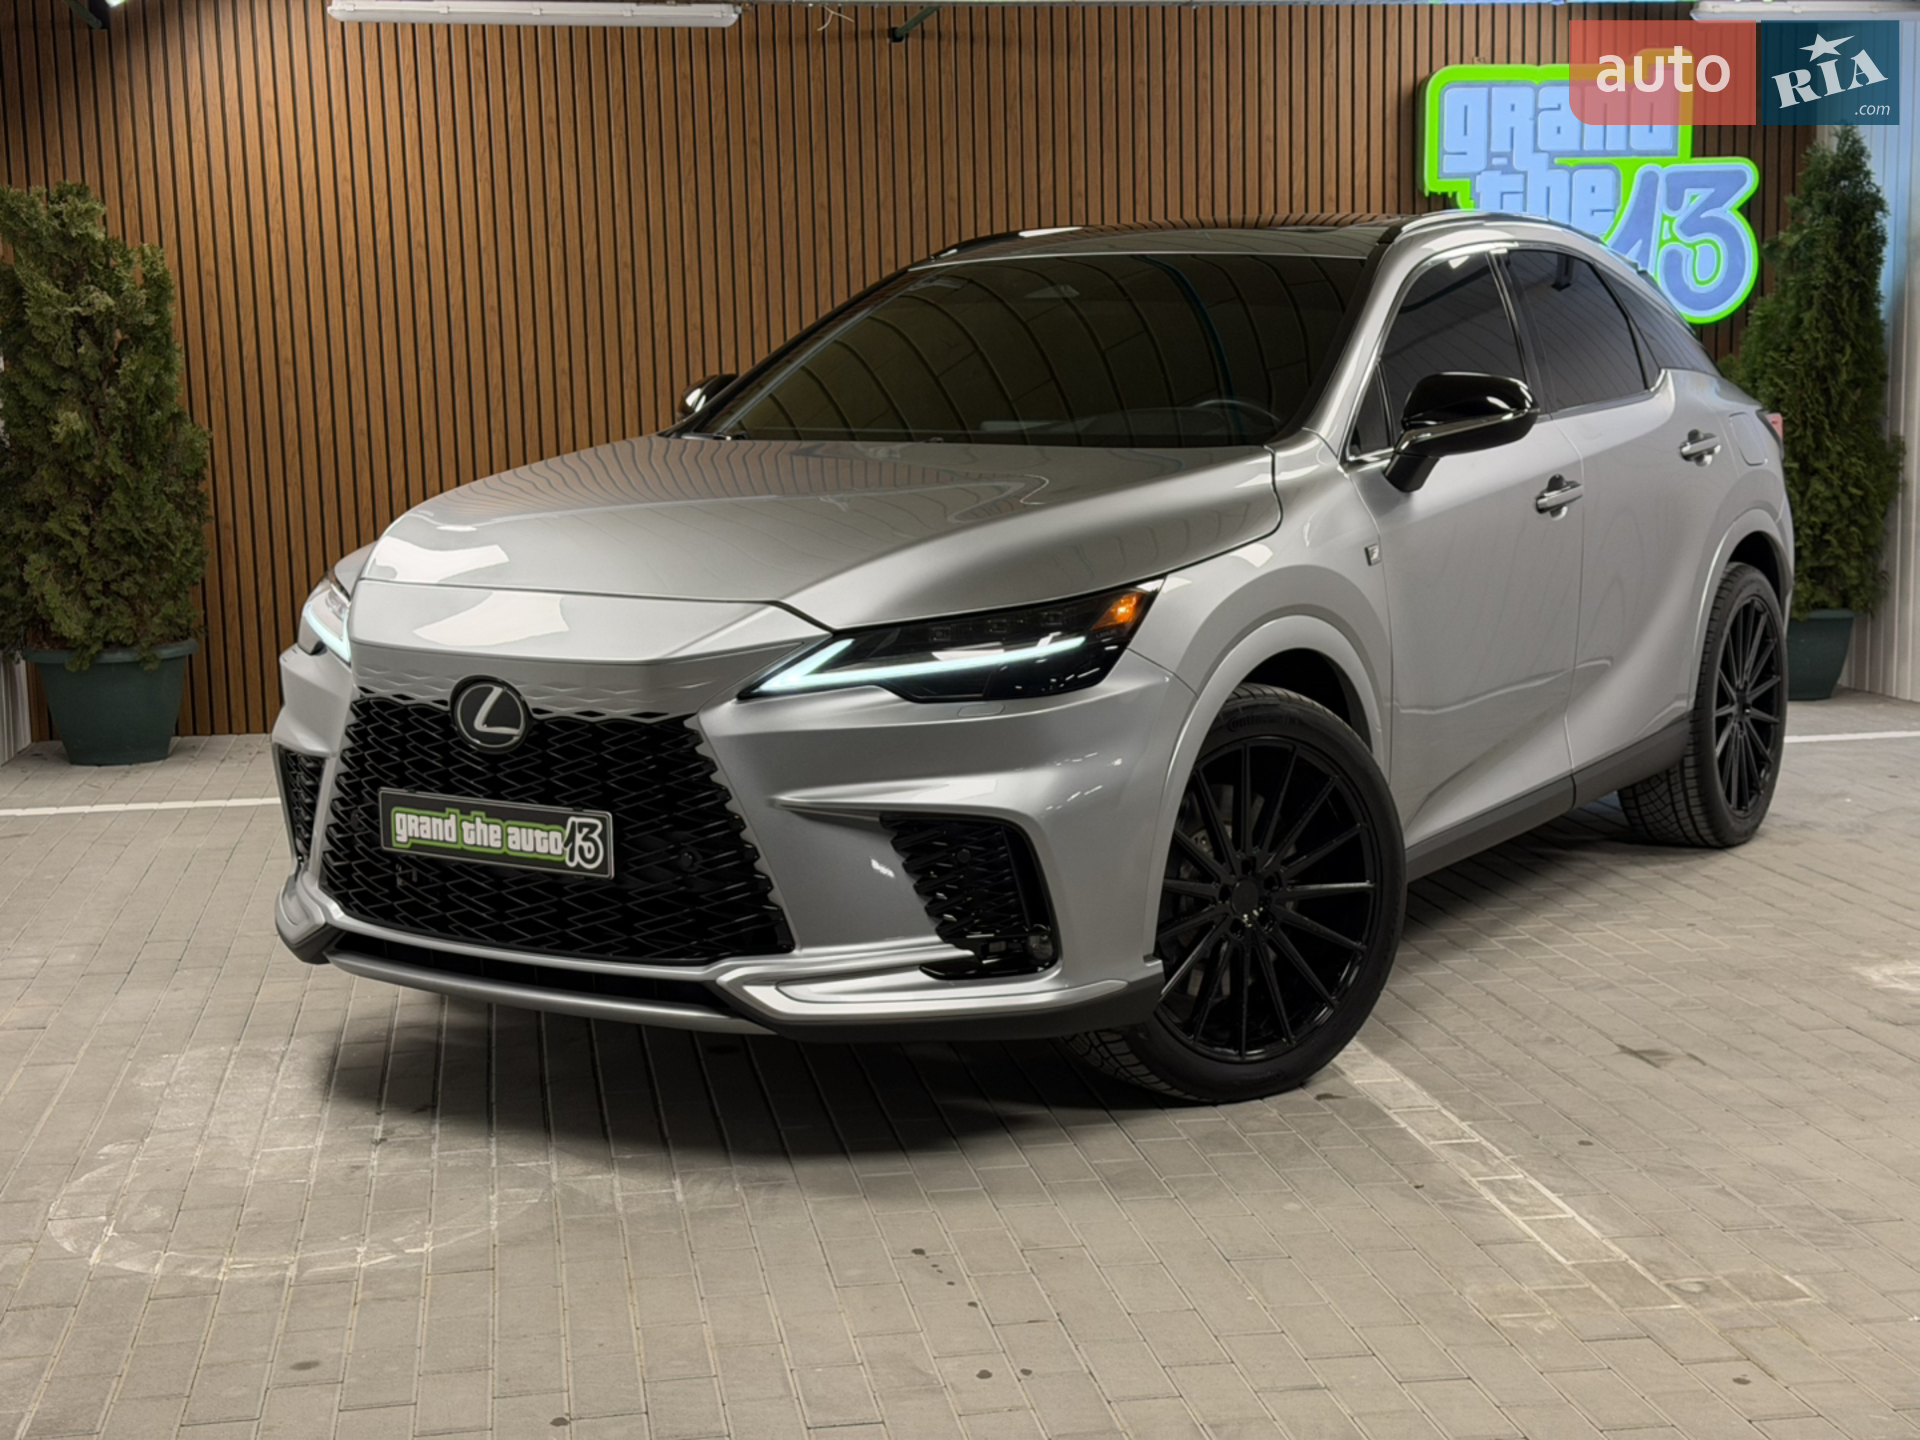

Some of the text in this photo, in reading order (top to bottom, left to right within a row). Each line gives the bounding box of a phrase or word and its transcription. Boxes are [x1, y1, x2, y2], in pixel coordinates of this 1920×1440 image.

[1607, 164, 1752, 317] 13
[461, 817, 503, 848] the
[507, 826, 564, 856] auto
[562, 816, 604, 869] 13
